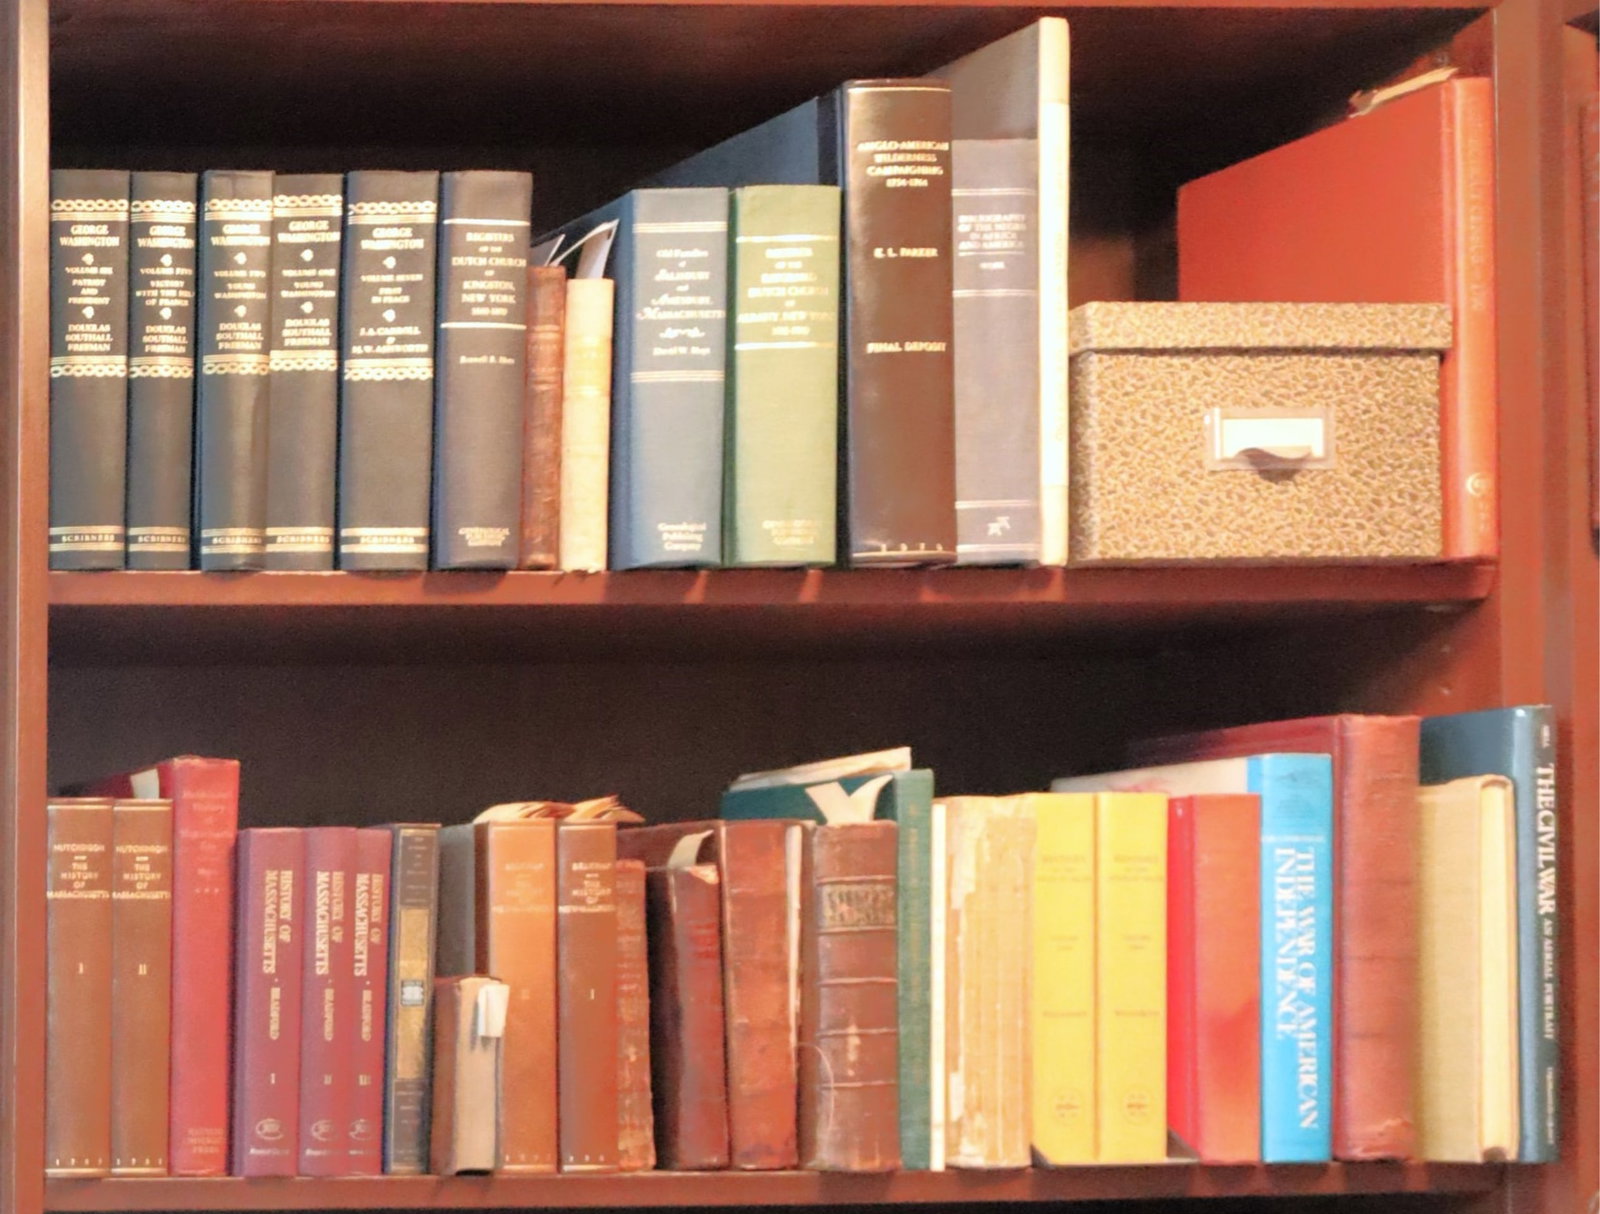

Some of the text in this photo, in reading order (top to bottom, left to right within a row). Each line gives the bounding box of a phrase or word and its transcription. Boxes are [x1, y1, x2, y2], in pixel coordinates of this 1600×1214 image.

[70, 224, 109, 236] GEORGE
[288, 221, 329, 232] GEORGE
[59, 236, 120, 247] WASHINGTON
[277, 231, 340, 243] WASHINGTON
[360, 238, 424, 250] WASHINGTON
[452, 256, 527, 267] DUTCH CHURCH
[461, 293, 516, 304] NEW YORK
[68, 323, 110, 333] DOUGLAS
[219, 322, 262, 332] DOUGLAS
[285, 318, 330, 328] DOUGLAS
[145, 325, 186, 334] DOUGLAS
[282, 327, 332, 337] SOUTHALL
[65, 333, 113, 343] SOUTHALL
[142, 334, 188, 344] SOUTHALL
[215, 331, 264, 341] SOUTHALL
[67, 343, 111, 352] FREEMAN
[218, 341, 262, 350] FREEMAN
[284, 337, 330, 347] FREEMAN
[145, 344, 186, 353] FREEMAN
[61, 534, 116, 543] SCRIBNERS
[276, 535, 330, 544] SCRIBNERS
[1536, 763, 1556, 810] THE
[1537, 810, 1557, 867] CIVIL
[73, 881, 86, 889] OF
[136, 882, 148, 890] OF
[1538, 867, 1557, 914] WAR
[279, 870, 293, 943] HISTORY OF
[331, 871, 344, 943] HISTORY OF
[370, 874, 384, 944] HISTORY OF
[262, 870, 278, 974] MASSACHUSETTS
[315, 871, 330, 975] MASSACHUSETTS
[354, 873, 370, 976] MASSACHUSETTS
[1543, 918, 1554, 936] AN
[1275, 848, 1298, 1040] INDEPENDENCE
[1297, 848, 1320, 1129] THE WAR OF AMERICAN
